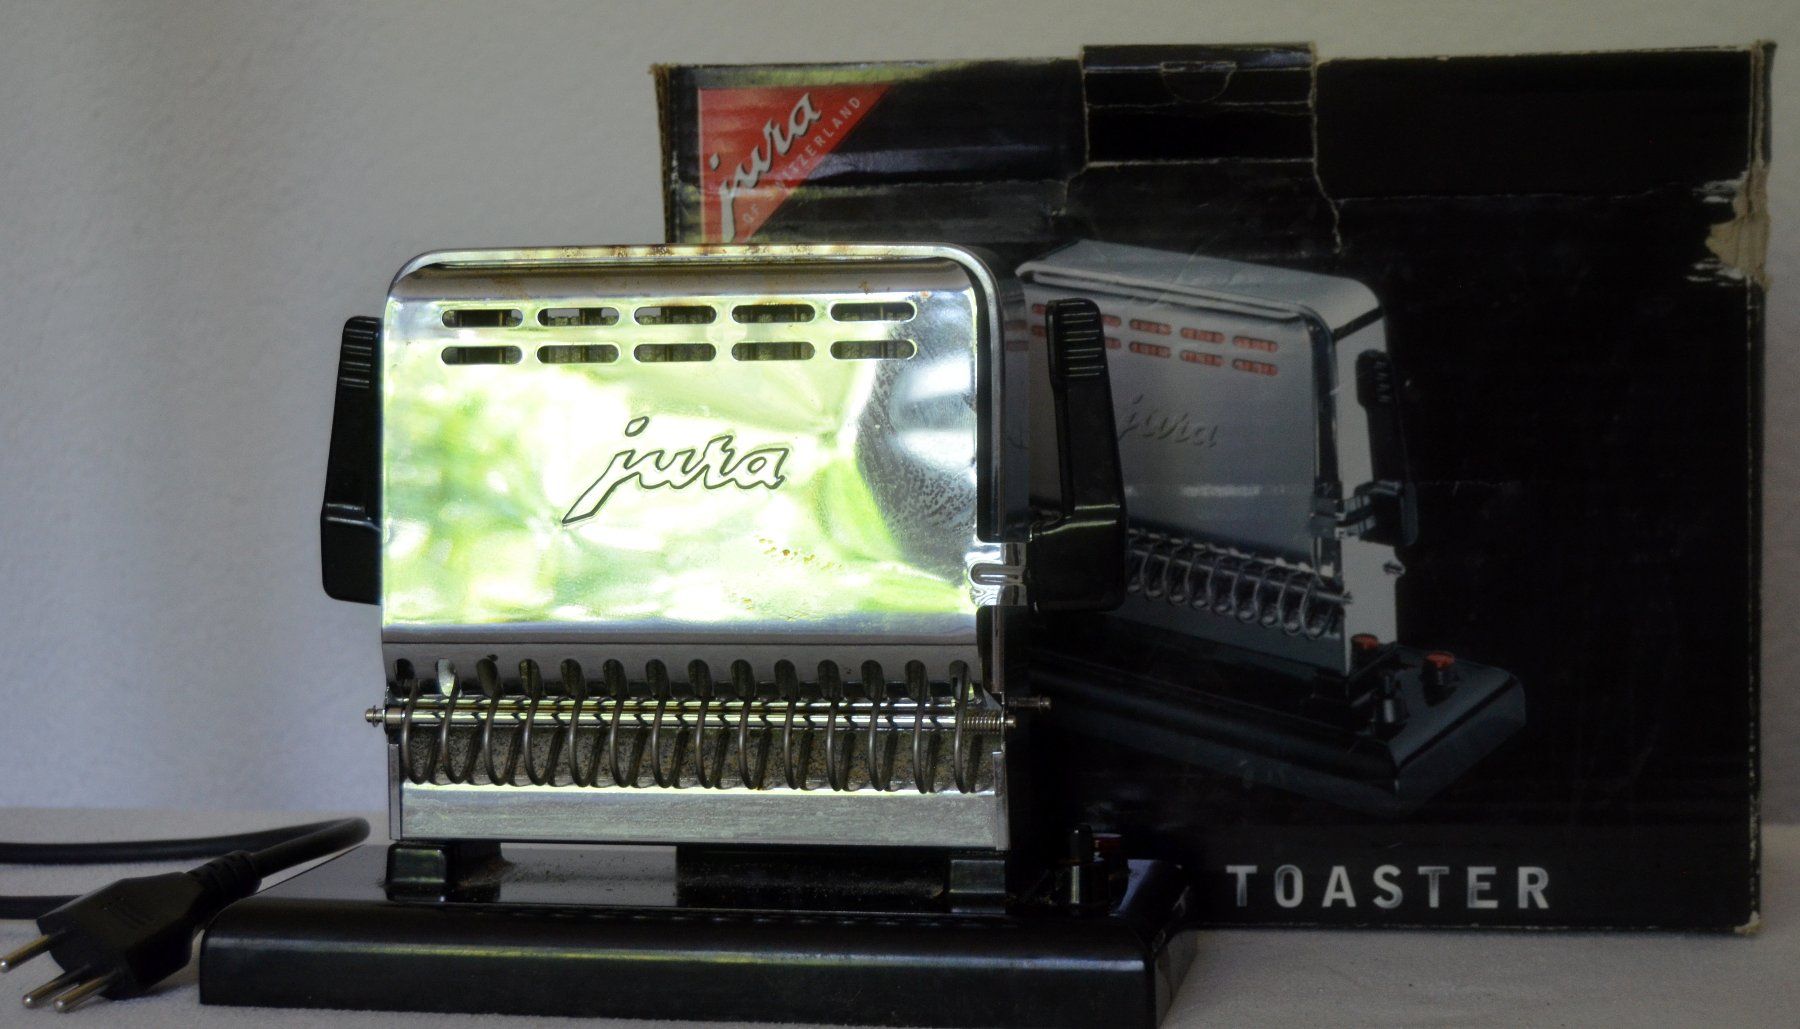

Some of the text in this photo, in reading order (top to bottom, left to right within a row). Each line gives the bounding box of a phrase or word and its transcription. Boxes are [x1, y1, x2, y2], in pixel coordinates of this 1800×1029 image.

[709, 92, 822, 243] jura
[767, 96, 862, 200] WITZERLAND
[562, 415, 790, 524] jura
[1225, 863, 1551, 910] TOASTER
